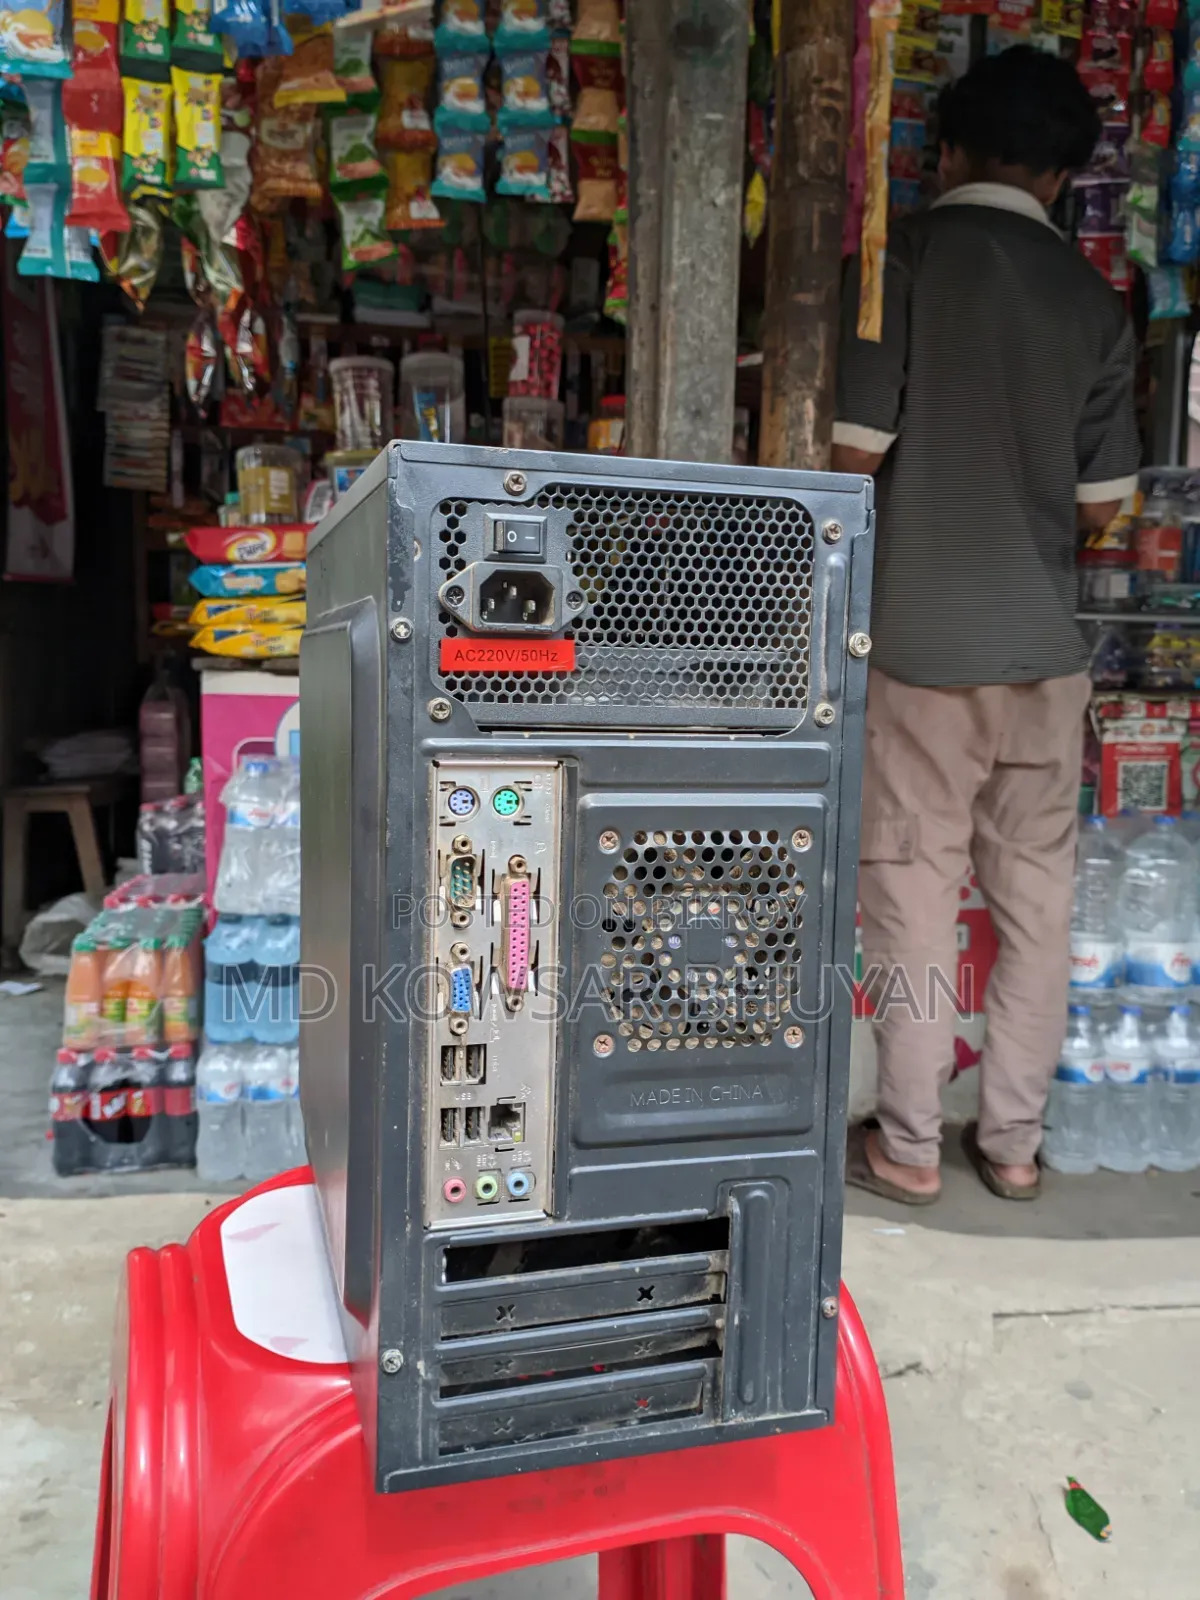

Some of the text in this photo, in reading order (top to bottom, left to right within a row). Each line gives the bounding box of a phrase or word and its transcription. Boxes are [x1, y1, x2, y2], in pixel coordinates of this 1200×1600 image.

[453, 649, 559, 662] AC220V/50Hz
[629, 1084, 763, 1107] MADE IN CHINA
